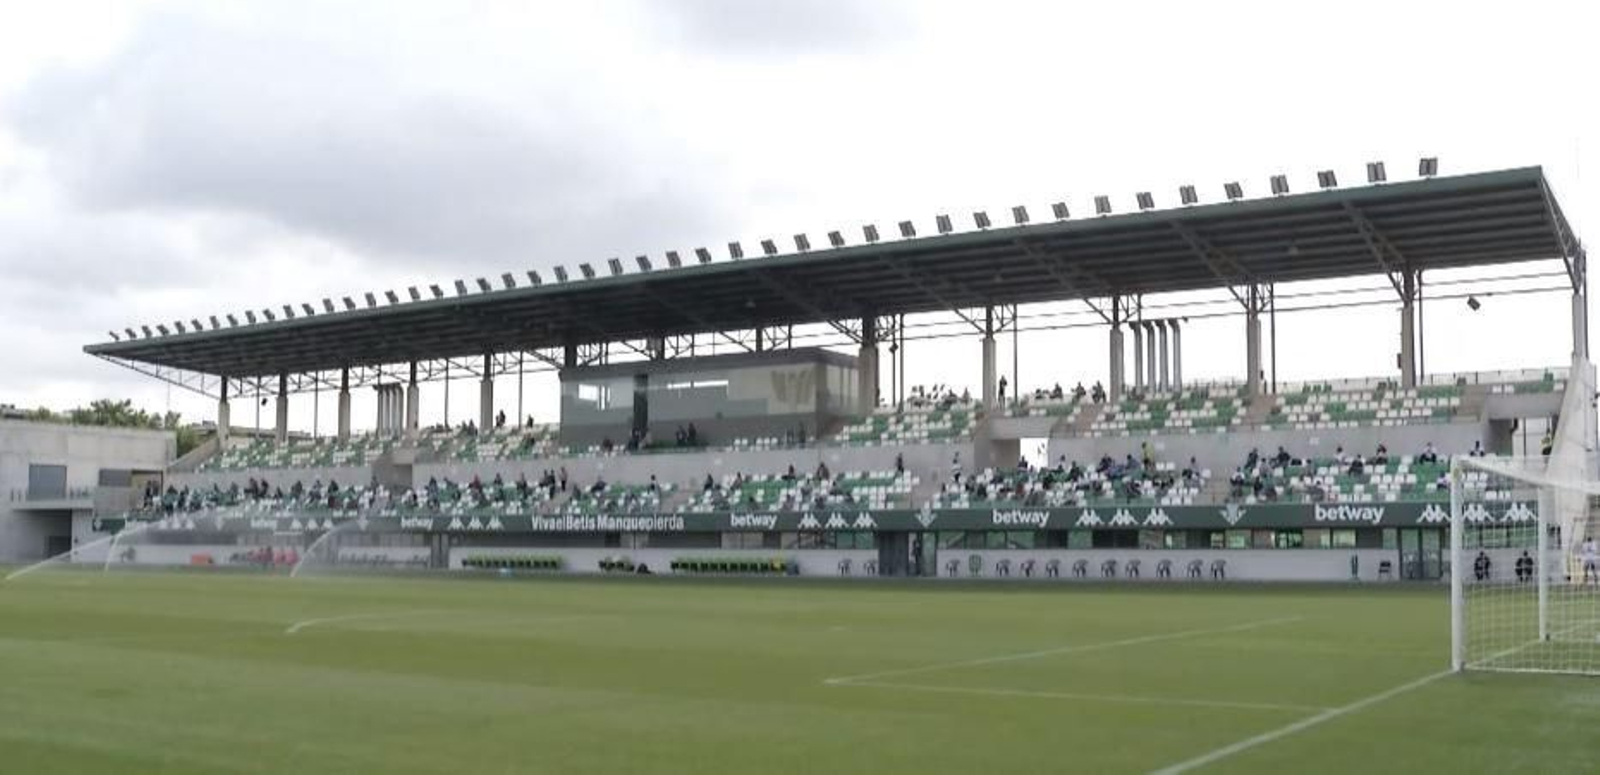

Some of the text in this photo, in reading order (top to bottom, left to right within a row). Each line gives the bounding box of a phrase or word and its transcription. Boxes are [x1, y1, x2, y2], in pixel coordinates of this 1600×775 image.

[730, 513, 777, 529] betway
[992, 509, 1049, 528] betway
[1315, 504, 1384, 524] betway
